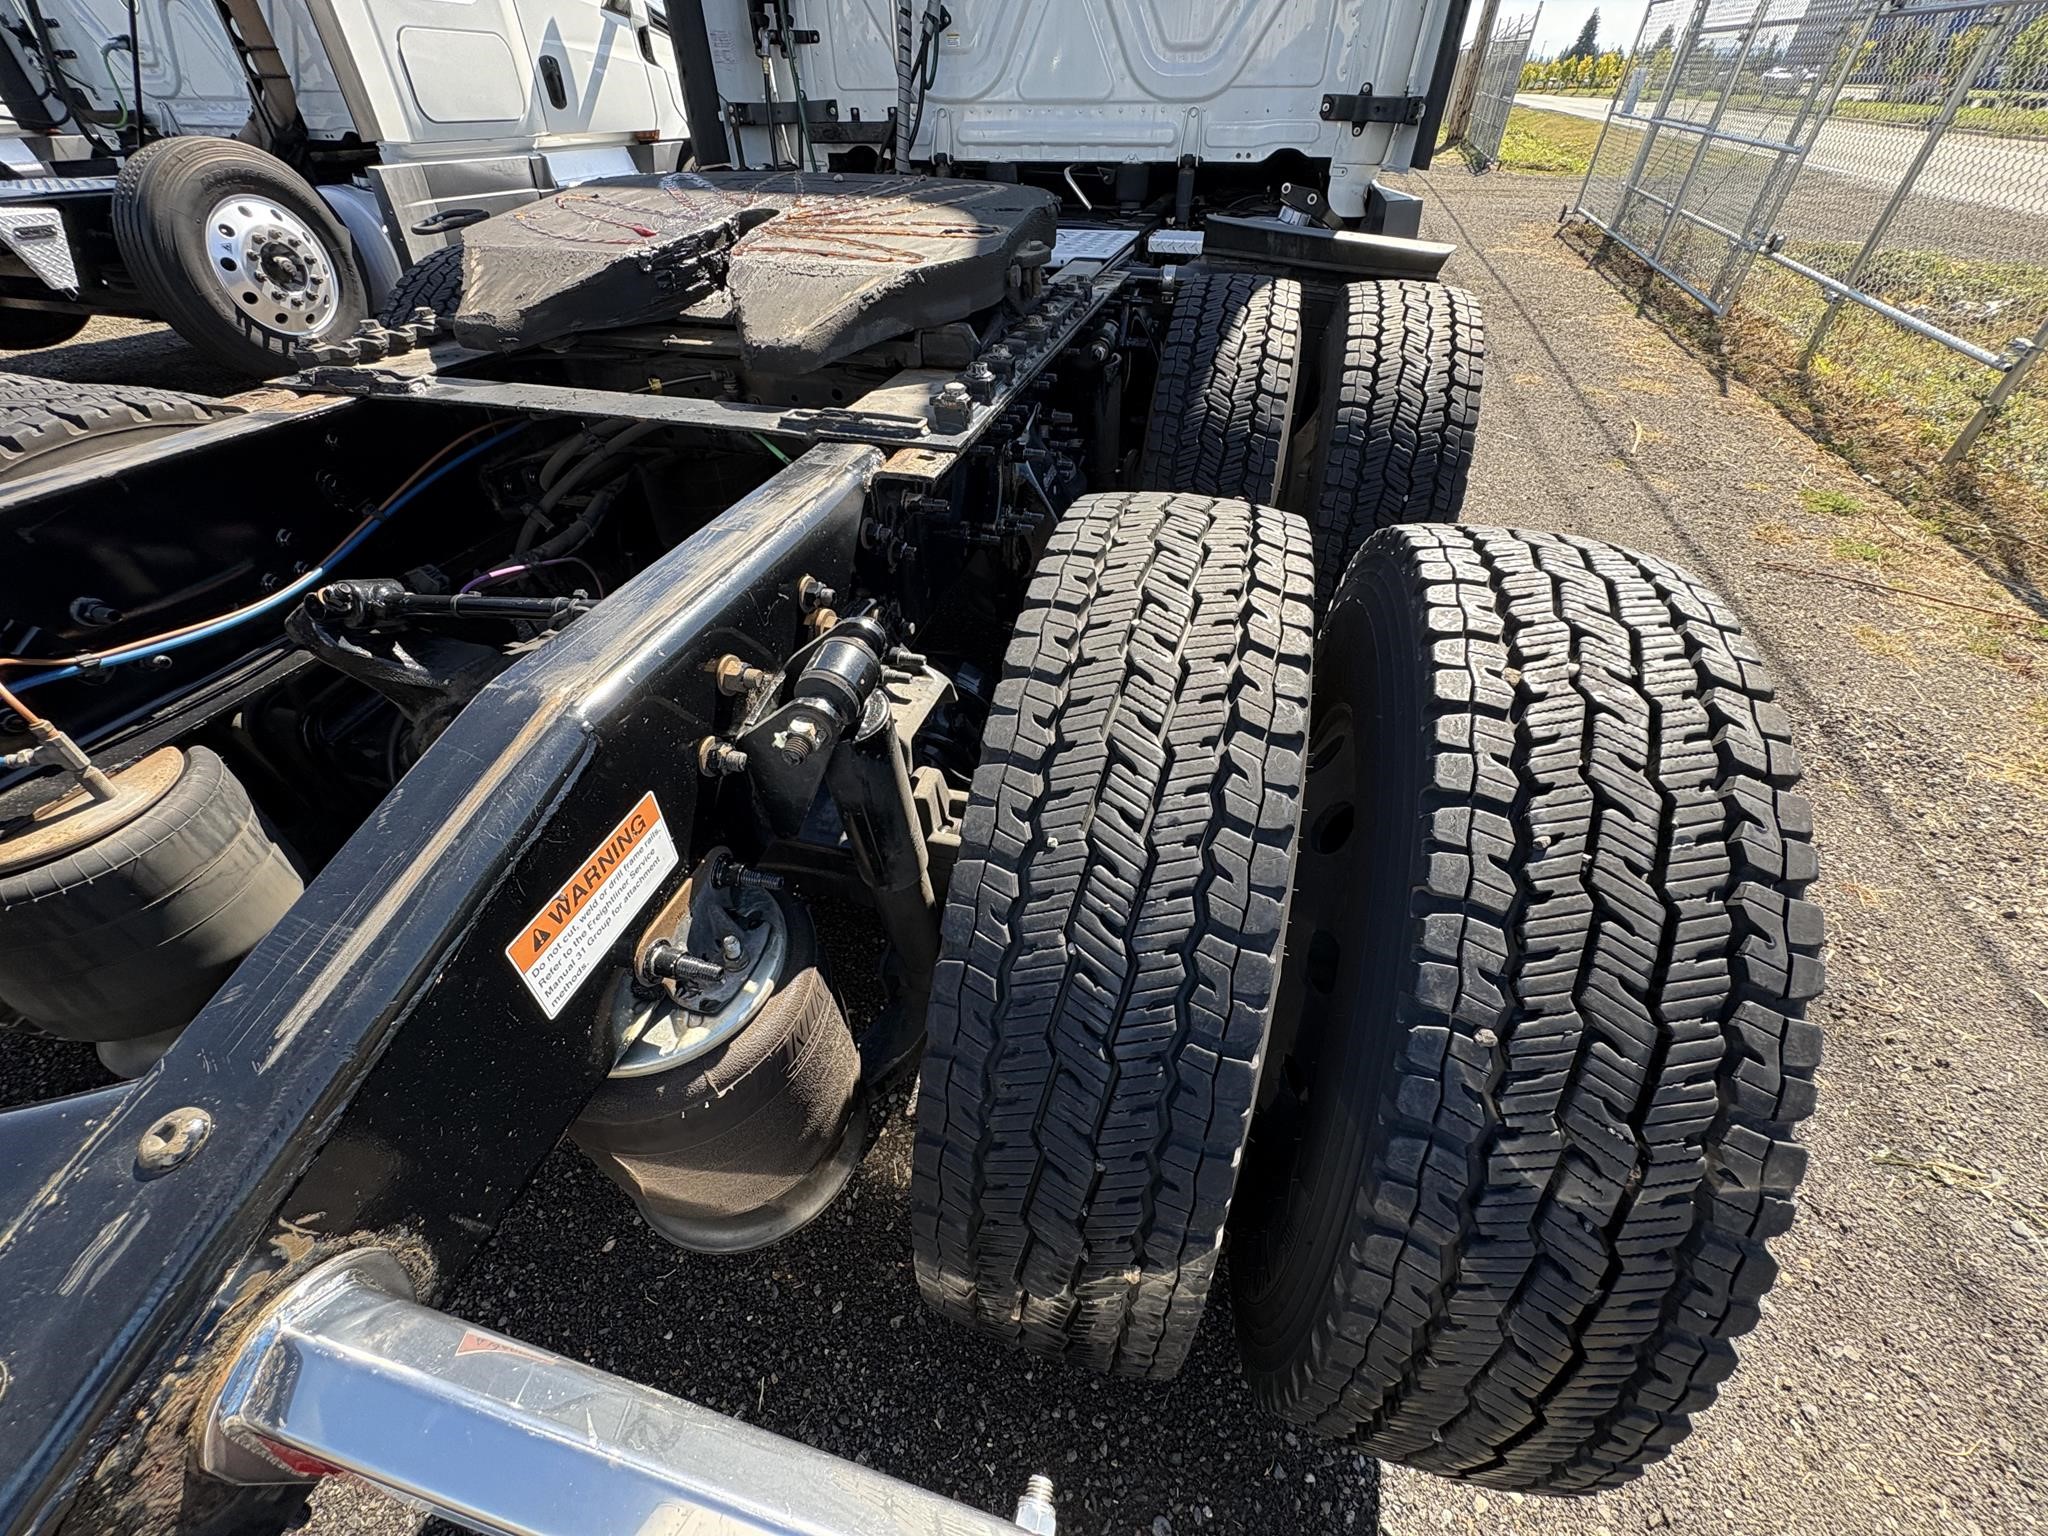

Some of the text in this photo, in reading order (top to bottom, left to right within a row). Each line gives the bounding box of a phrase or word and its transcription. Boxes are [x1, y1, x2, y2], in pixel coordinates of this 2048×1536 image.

[532, 962, 546, 978] Do
[547, 942, 562, 962] not
[579, 899, 599, 923] weld
[599, 889, 608, 901] or
[608, 869, 624, 889] drill
[623, 846, 645, 872] frame
[538, 848, 656, 988] Refer to the Freightliner Service
[544, 959, 577, 998] Manual
[587, 916, 613, 947] Group
[611, 902, 623, 917] for
[623, 856, 661, 904] attachment
[548, 815, 647, 925] WARNING
[551, 962, 590, 1008] methods.
